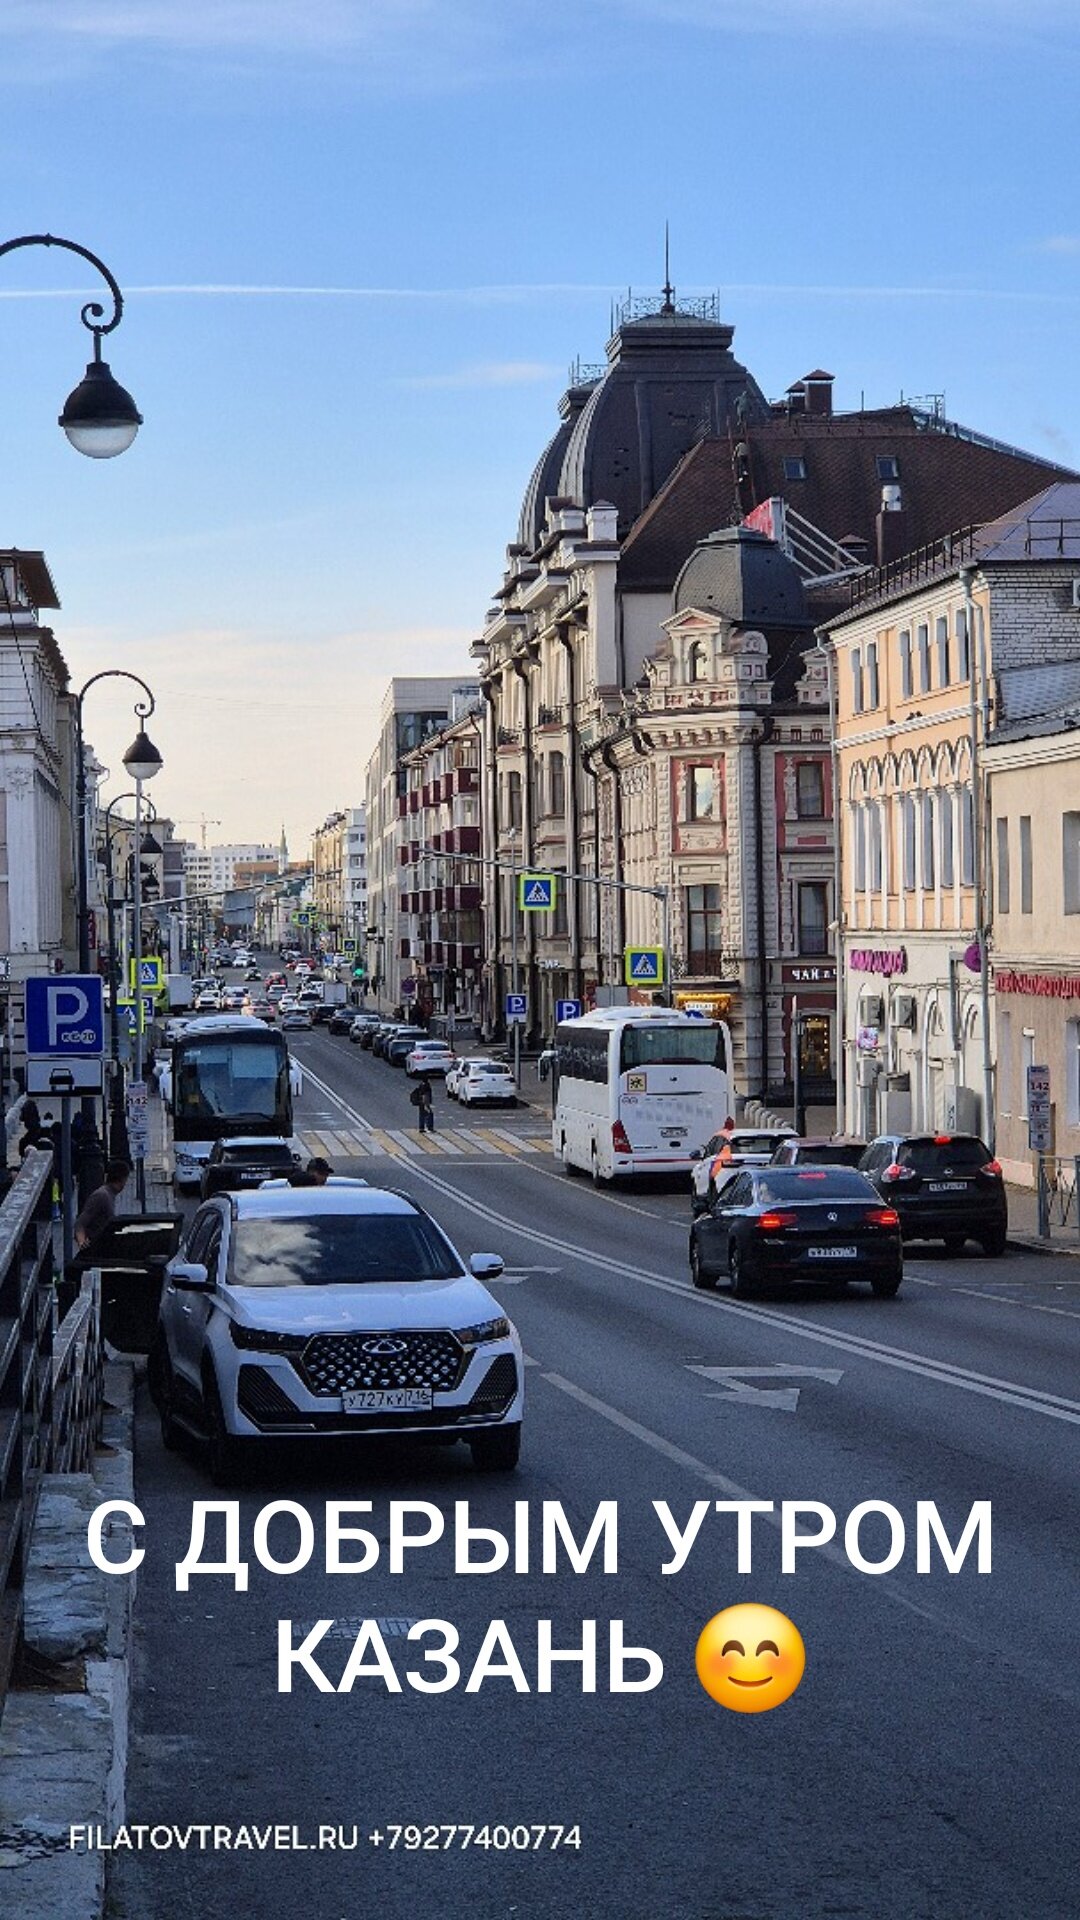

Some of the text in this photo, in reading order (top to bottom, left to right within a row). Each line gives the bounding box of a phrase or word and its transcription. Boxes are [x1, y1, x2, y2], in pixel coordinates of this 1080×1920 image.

[511, 997, 523, 1012] P
[563, 1002, 576, 1020] P
[47, 986, 89, 1046] P
[1031, 1082, 1049, 1091] 142
